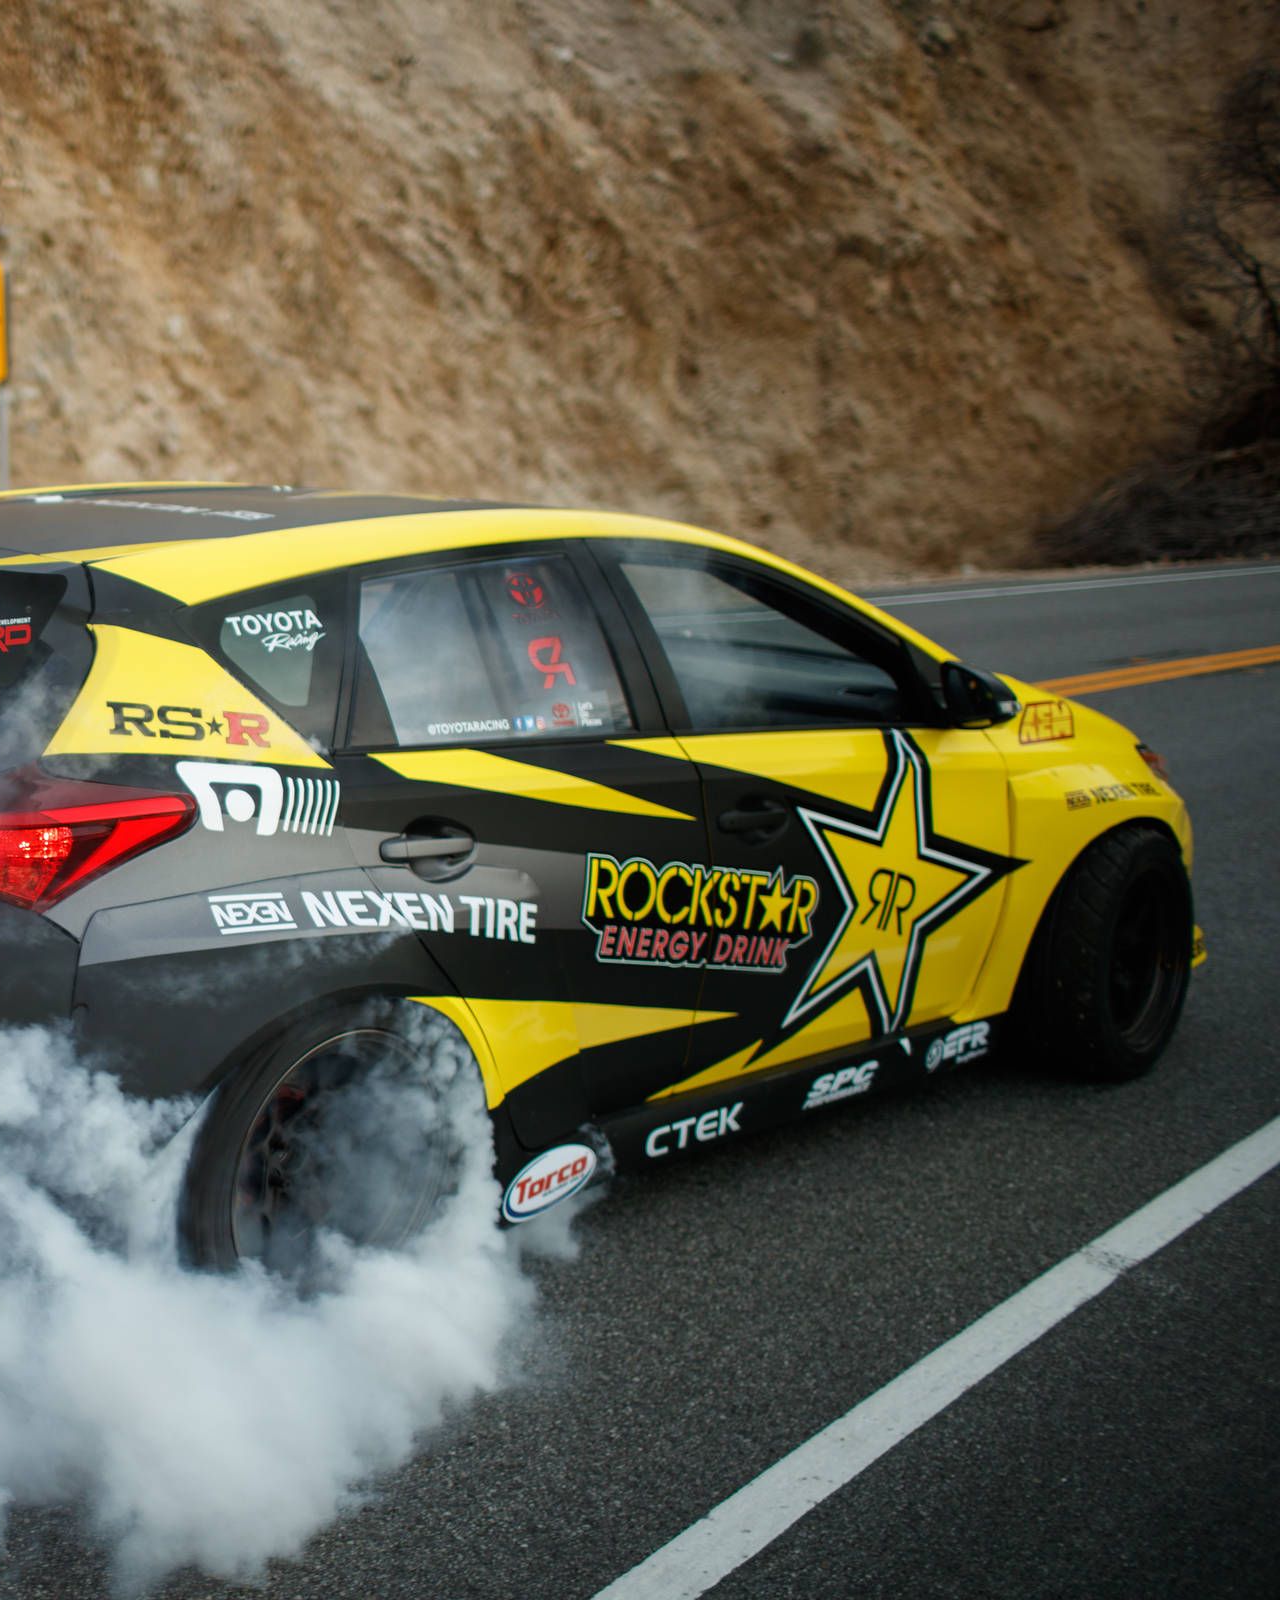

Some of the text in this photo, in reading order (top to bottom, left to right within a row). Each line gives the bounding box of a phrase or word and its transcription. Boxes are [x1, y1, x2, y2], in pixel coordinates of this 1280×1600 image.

[223, 609, 323, 636] TOYOTA
[261, 630, 326, 652] Racing
[428, 719, 510, 736] @TOYOTARACING
[209, 890, 538, 944] NEXEN NEXEN TIRE
[600, 926, 788, 966] ENERGY DRINK
[807, 1059, 879, 1099] SPC
[645, 1102, 744, 1158] CTEK
[517, 1156, 588, 1206] Torco
